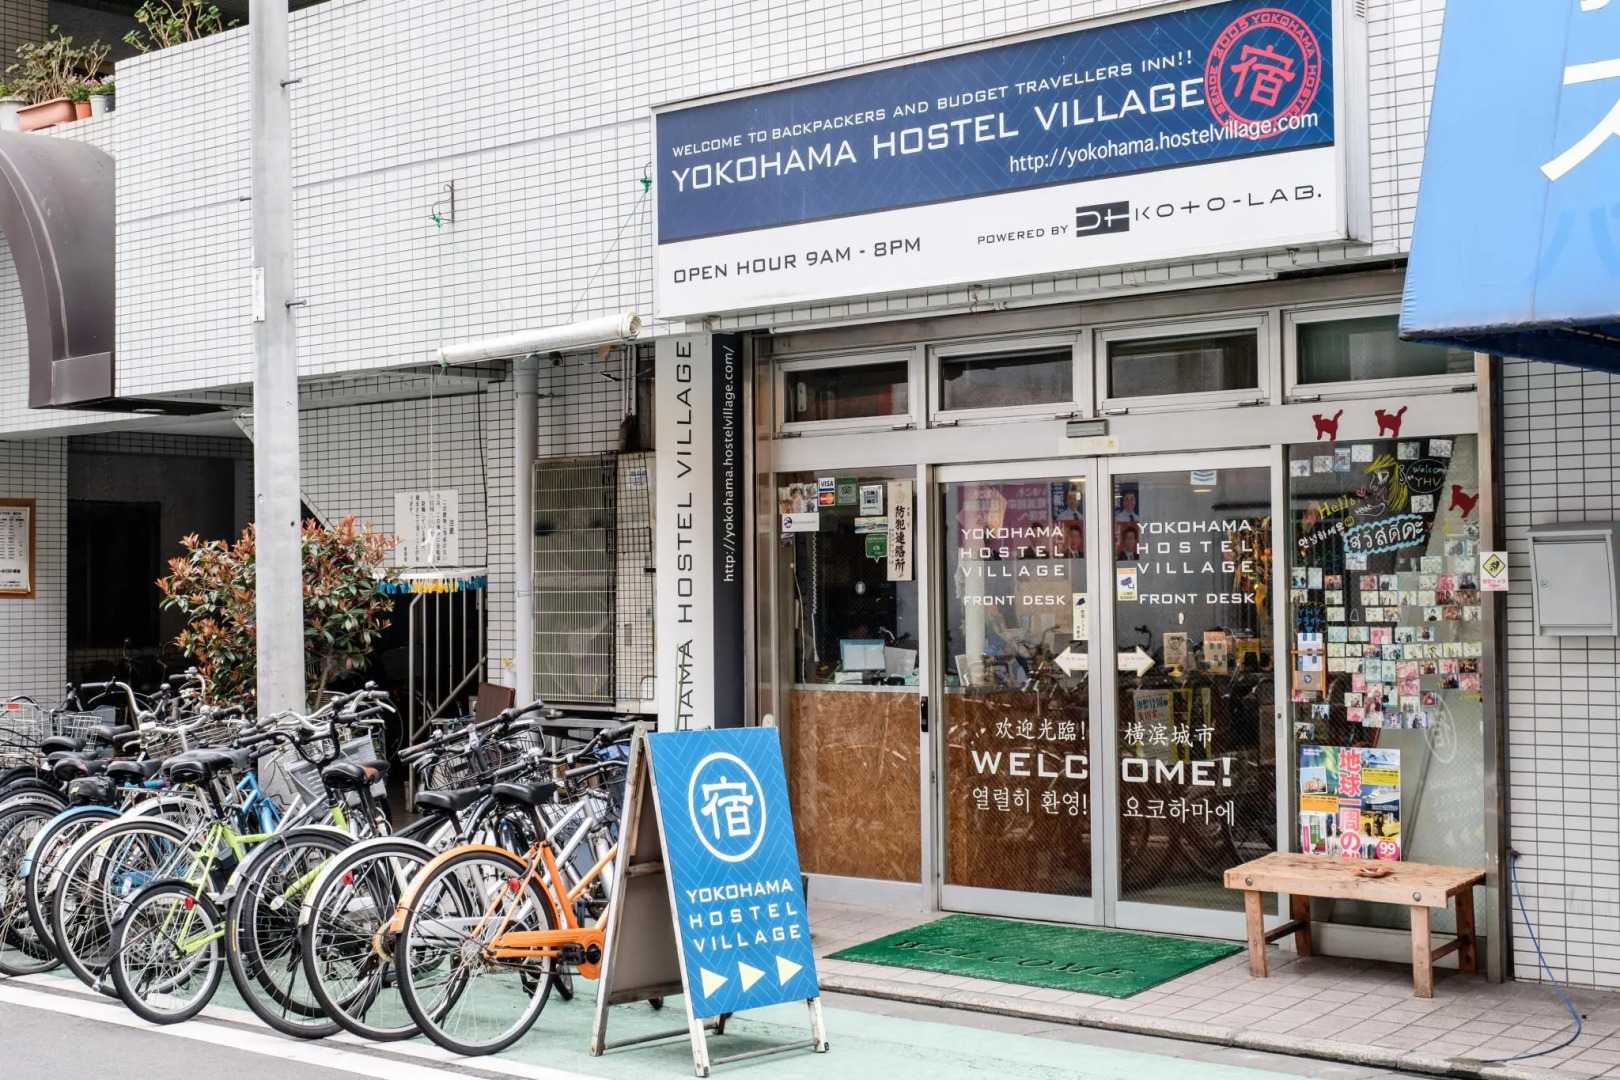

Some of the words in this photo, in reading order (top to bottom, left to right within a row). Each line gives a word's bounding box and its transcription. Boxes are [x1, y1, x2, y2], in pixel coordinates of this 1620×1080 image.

[1213, 18, 1249, 59] 2005
[1251, 13, 1316, 59] YOKOHAMA
[1230, 44, 1296, 107] 宿
[672, 135, 742, 158] WELCOME
[748, 131, 767, 145] TO
[772, 109, 886, 140] BACKPACKERS
[893, 101, 929, 118] AND
[937, 86, 1008, 110] BUDGET
[1015, 62, 1132, 96] TRAVELLERS
[1142, 50, 1193, 73] INN!!
[672, 140, 857, 192] YOKOHAMA
[873, 113, 1019, 160] HOSTEL
[1034, 77, 1205, 131] VILLAGE
[1009, 111, 1319, 173] http://yokohama.hostelvillage.com
[977, 228, 1045, 245] POWERED
[1051, 225, 1069, 237] BY
[673, 263, 728, 284] OPEN
[736, 254, 797, 276] HOUR
[805, 246, 851, 267] 9AM
[873, 236, 922, 258] 8PM
[676, 341, 692, 478] VILLAGE
[722, 345, 736, 582] http://yokohama.hostelvillage.com/
[820, 480, 834, 488] VISA
[1415, 477, 1442, 488] YHV
[1315, 494, 1356, 520] Hello
[962, 526, 1064, 540] YOKOHAMA
[1137, 519, 1252, 535] YOKOHAMA
[1298, 522, 1345, 549] 안녕하세요
[677, 492, 693, 623] HOSTEL
[961, 545, 1064, 559] HOSTEL
[1136, 540, 1252, 555] HOSTEL
[962, 564, 1064, 577] VILLAGE
[1137, 561, 1253, 574] VILLAGE
[963, 595, 1015, 606] FRONT
[1023, 595, 1066, 606] DESK
[1139, 593, 1198, 604] FRONT
[1206, 593, 1255, 604] DESK
[1123, 722, 1215, 749] 横滨城市
[701, 776, 754, 840] 宿
[972, 785, 1031, 814] 열렬히
[1041, 790, 1088, 816] 환영!
[1123, 795, 1235, 827] 요코하마에
[1380, 842, 1396, 854] 99
[686, 878, 793, 904] YOKOHAMA
[689, 902, 798, 929] HOSTEL
[693, 924, 801, 953] VILLAGE
[894, 939, 1136, 978] WELCOME
